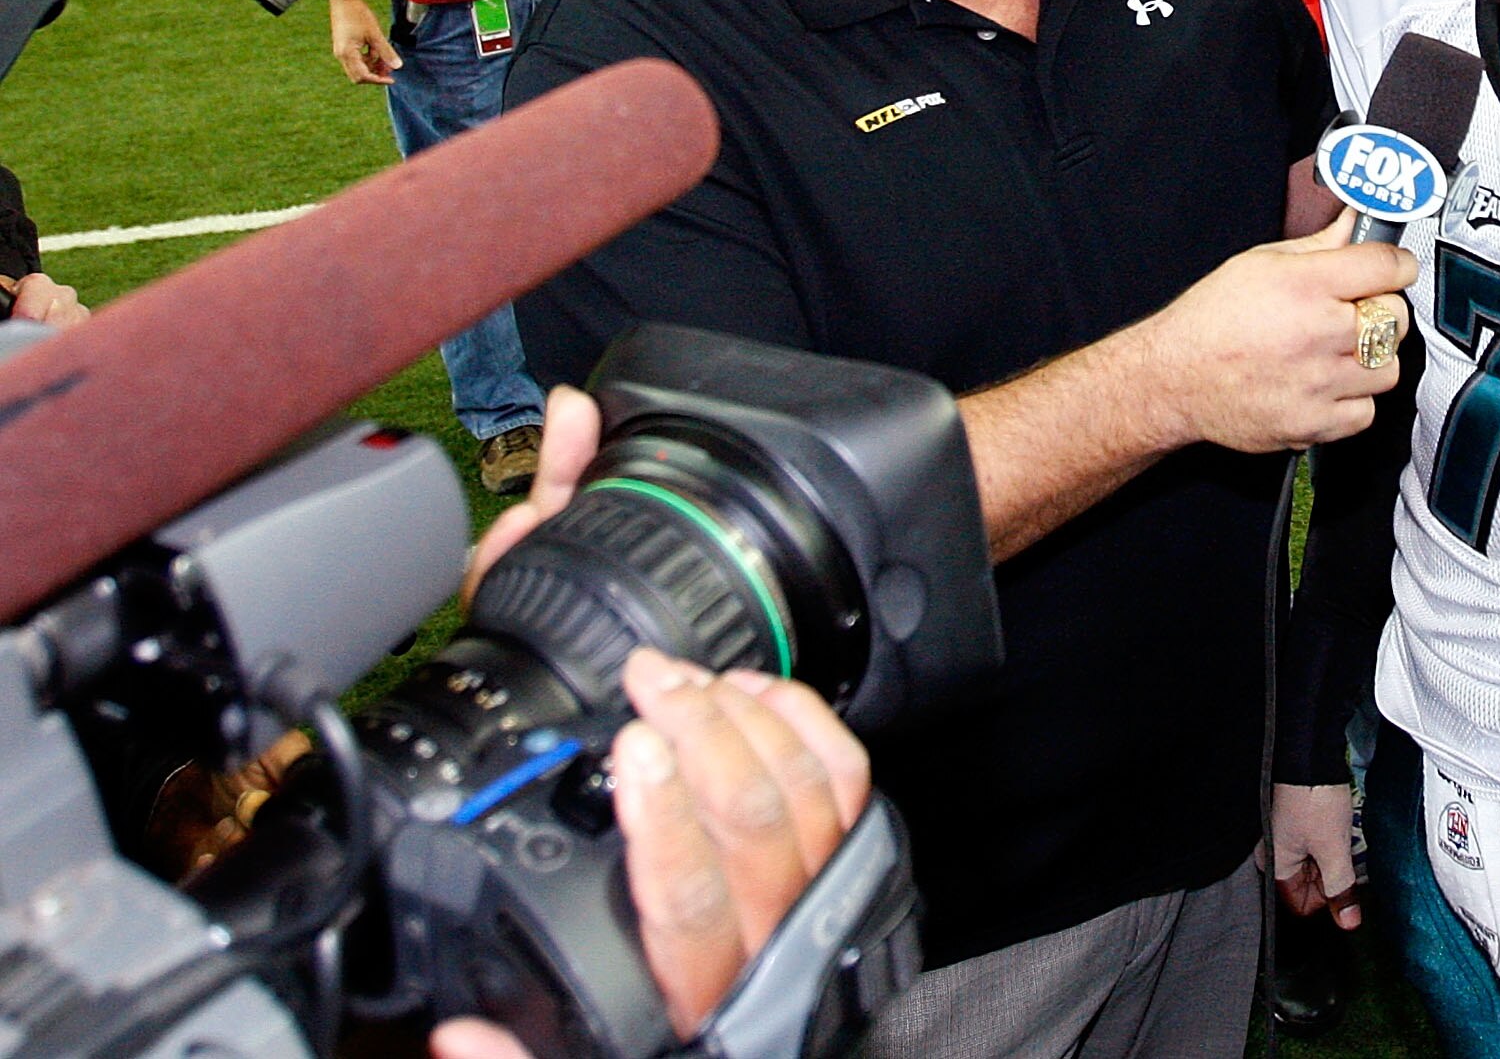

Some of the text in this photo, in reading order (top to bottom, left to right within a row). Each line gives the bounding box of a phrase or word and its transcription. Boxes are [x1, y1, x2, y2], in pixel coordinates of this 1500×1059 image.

[865, 107, 902, 130] NFL
[1340, 134, 1429, 201] FOX
[1335, 171, 1415, 211] SPORTS
